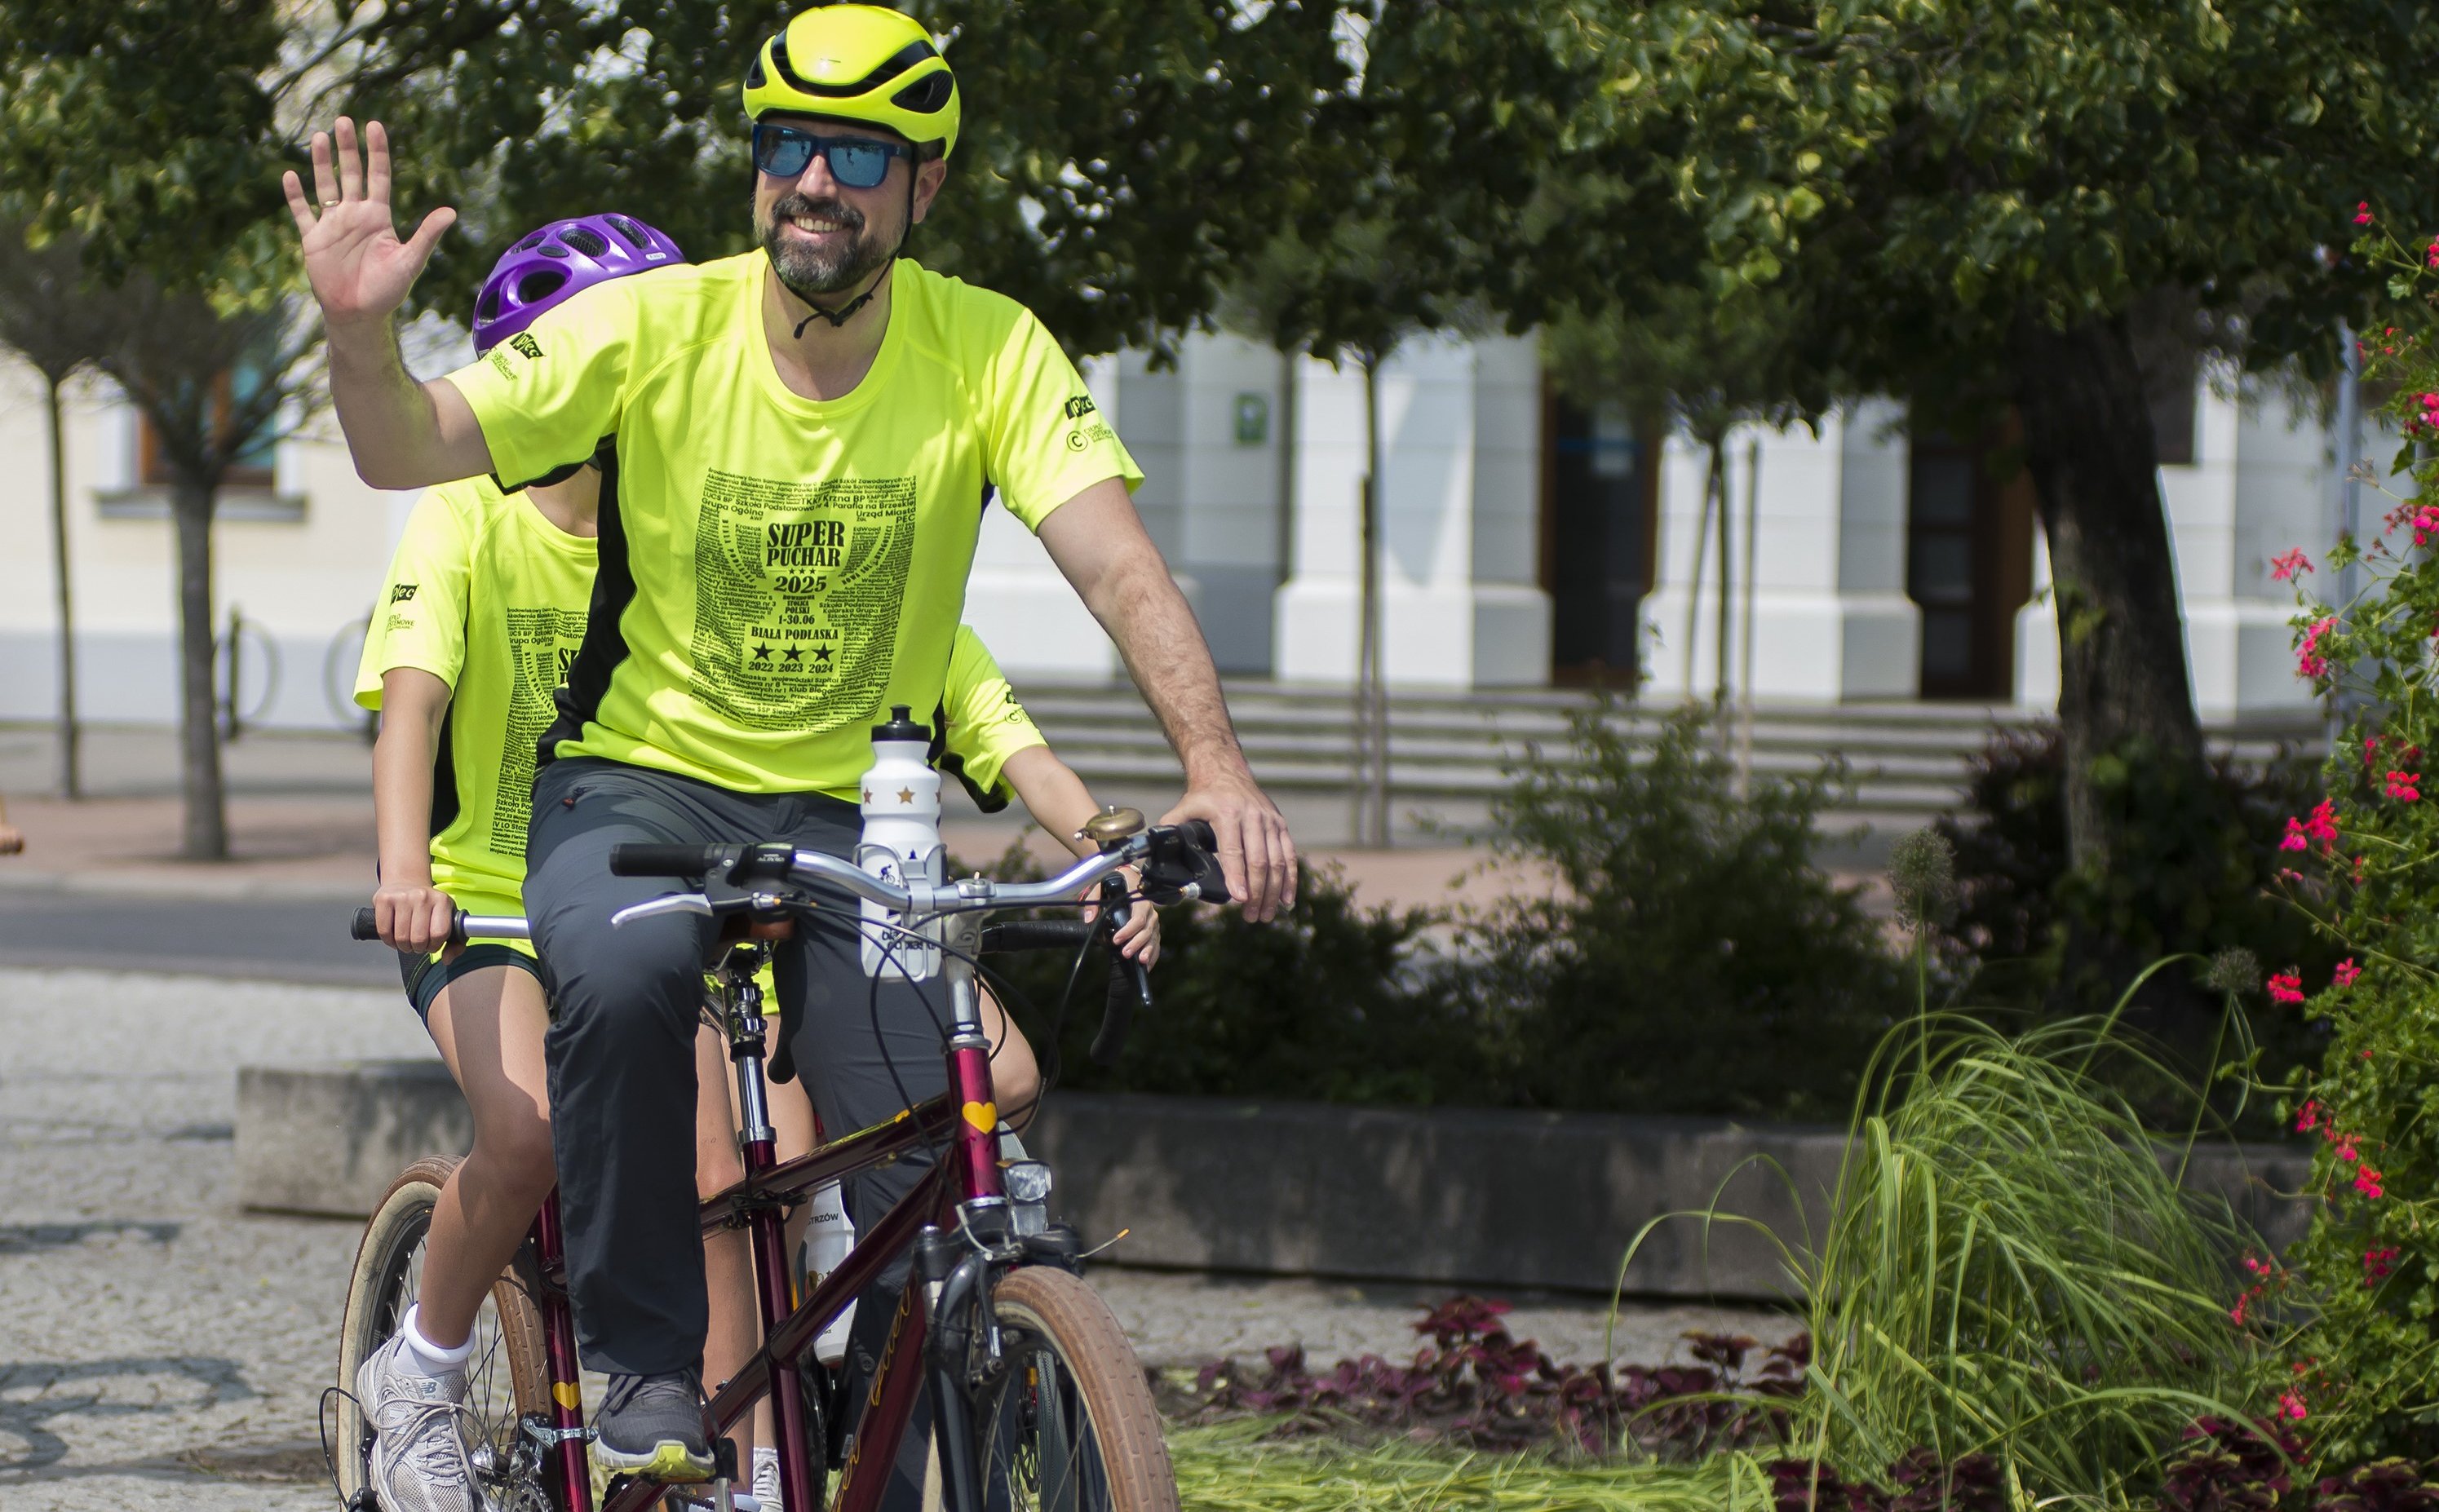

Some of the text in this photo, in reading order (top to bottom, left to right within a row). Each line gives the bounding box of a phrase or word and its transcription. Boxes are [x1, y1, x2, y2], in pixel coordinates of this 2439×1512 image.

[707, 474, 739, 485] Akademia
[702, 497, 764, 516] Grupa Ogólna
[703, 490, 721, 501] LUCS
[736, 497, 761, 508] Szkoła
[764, 503, 814, 511] Podstawowa
[857, 511, 883, 519] Urząd
[896, 514, 914, 523] PEC
[767, 520, 844, 547] SUPER
[766, 547, 840, 567] PUCHAR
[773, 576, 827, 594] 2025
[779, 615, 815, 625] 1-30.06
[555, 630, 584, 639] Podstaw
[751, 626, 839, 640] BIAŁA PODLASKA
[748, 661, 834, 673] 2022 2023 2024
